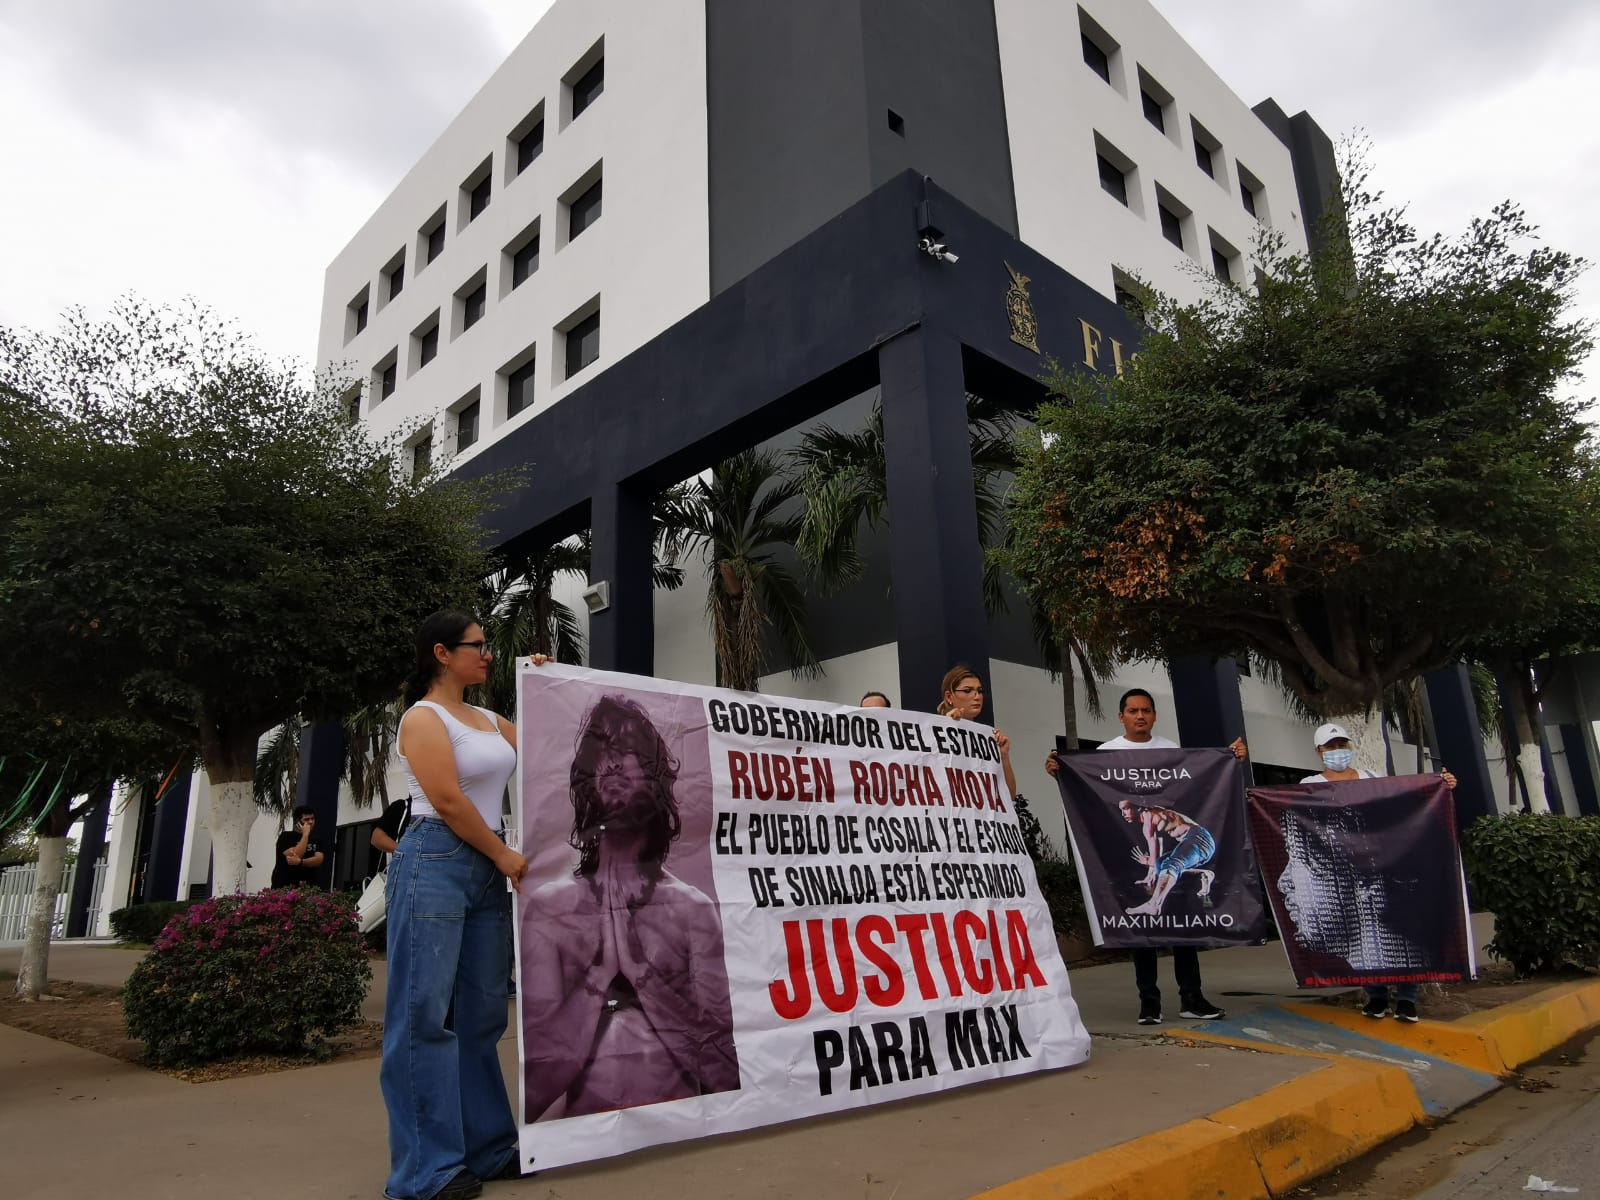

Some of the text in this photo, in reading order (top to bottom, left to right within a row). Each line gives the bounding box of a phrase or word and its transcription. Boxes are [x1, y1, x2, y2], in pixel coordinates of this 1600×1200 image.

[708, 699, 1000, 764] GOBERNADOR DEL ESTADO
[727, 747, 1007, 813] RUBÉN ROCHA MOYA
[1100, 768, 1192, 781] JUSTICIA
[1134, 780, 1162, 788] PARA
[716, 809, 1027, 856] EL PUEBLO DE COSALÁ Y EL ESTADO
[748, 855, 1026, 908] DE SINALOA ESTÁ ESPERANDO
[1102, 913, 1234, 928] MAXIMILIANO
[769, 910, 1047, 1020] JUSTICIA
[812, 1004, 1032, 1096] PARA MAX
